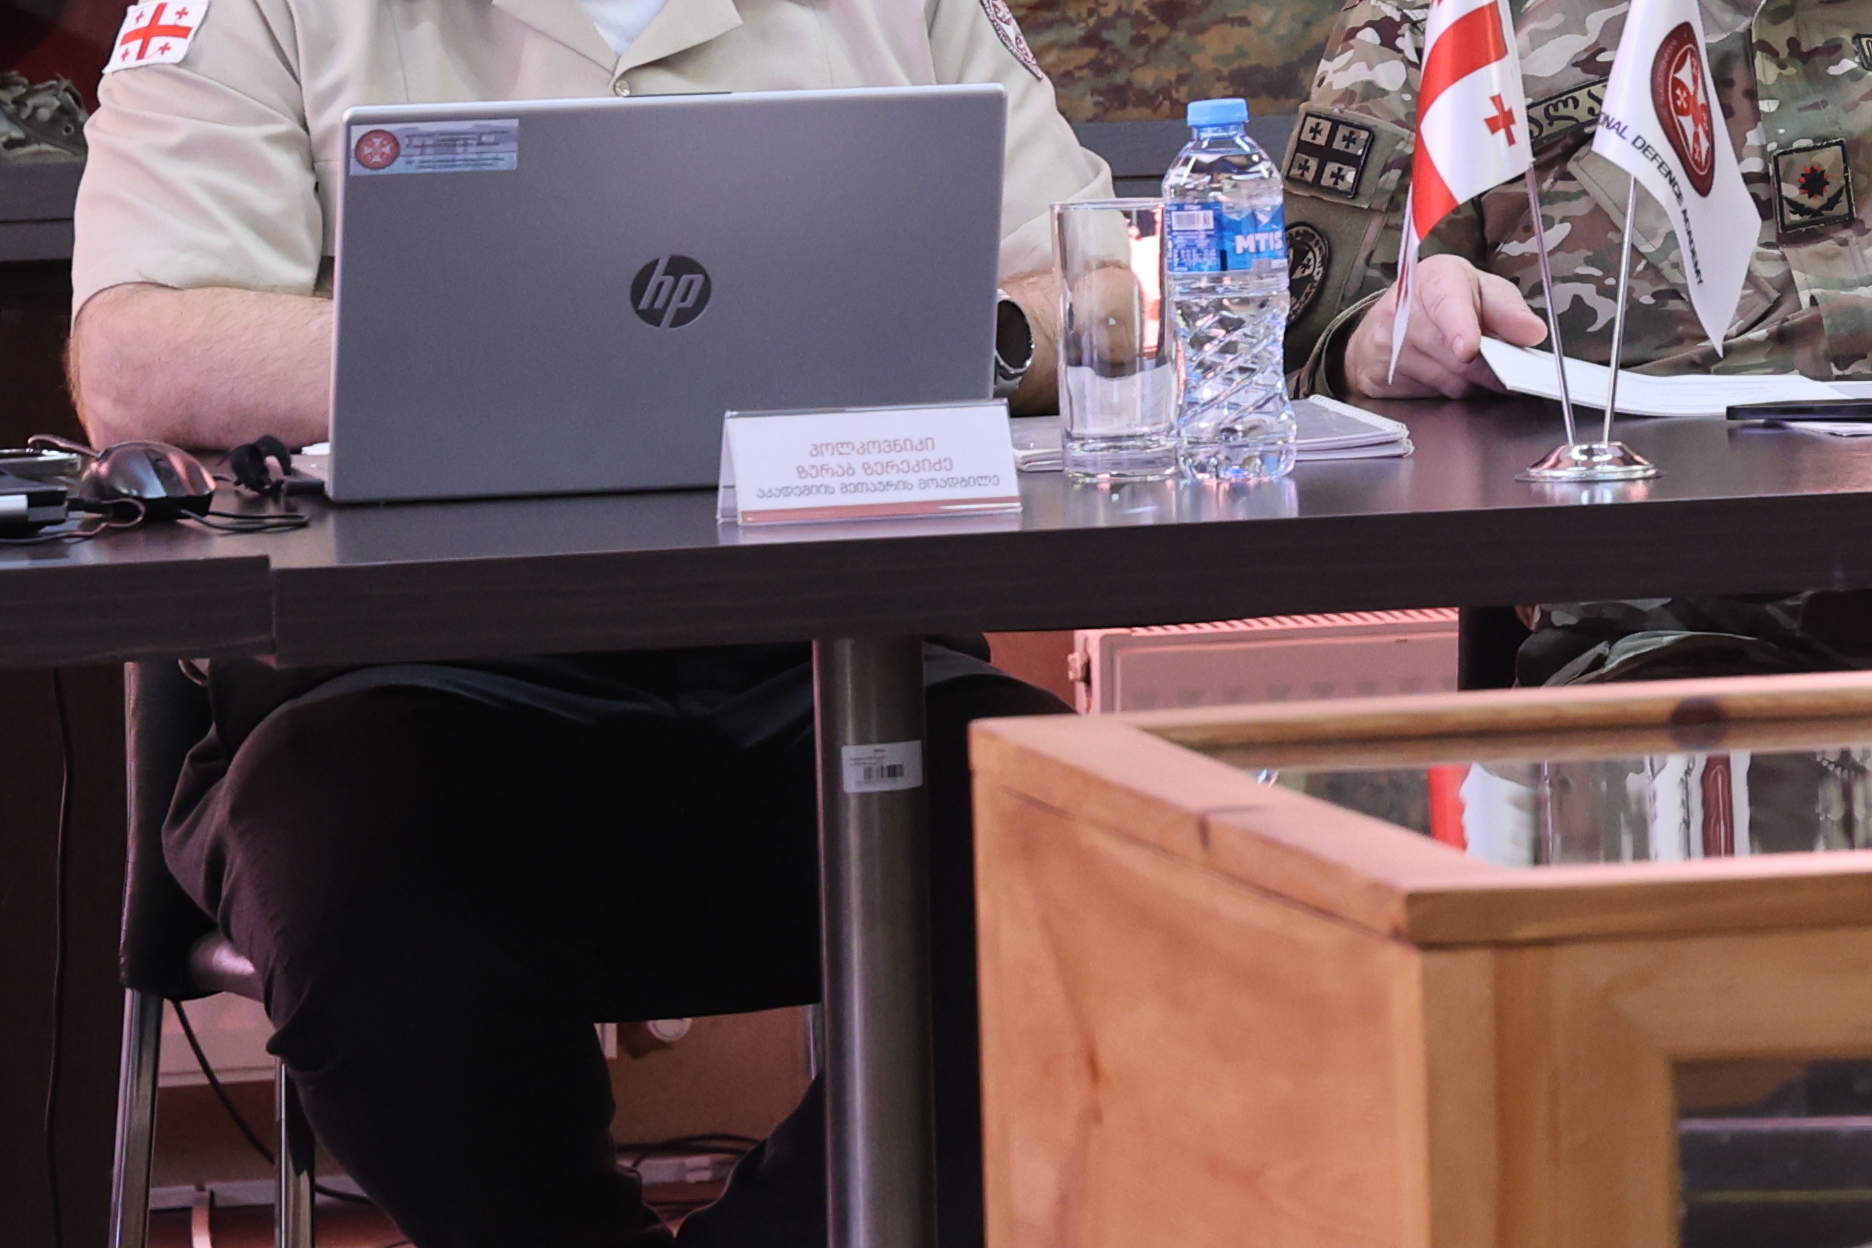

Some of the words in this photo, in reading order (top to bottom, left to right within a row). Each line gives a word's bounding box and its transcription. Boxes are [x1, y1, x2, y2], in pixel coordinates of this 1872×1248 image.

[1631, 134, 1684, 208] DEFENCE
[638, 255, 706, 328] hp
[809, 436, 936, 458] პოლკოვნიკი
[796, 460, 856, 480] ზურაბ
[862, 457, 954, 477] ზერეკიძე
[756, 482, 835, 499] აკადემიის
[839, 479, 914, 495] მეთაურის
[918, 475, 1001, 490] მოადგილე
